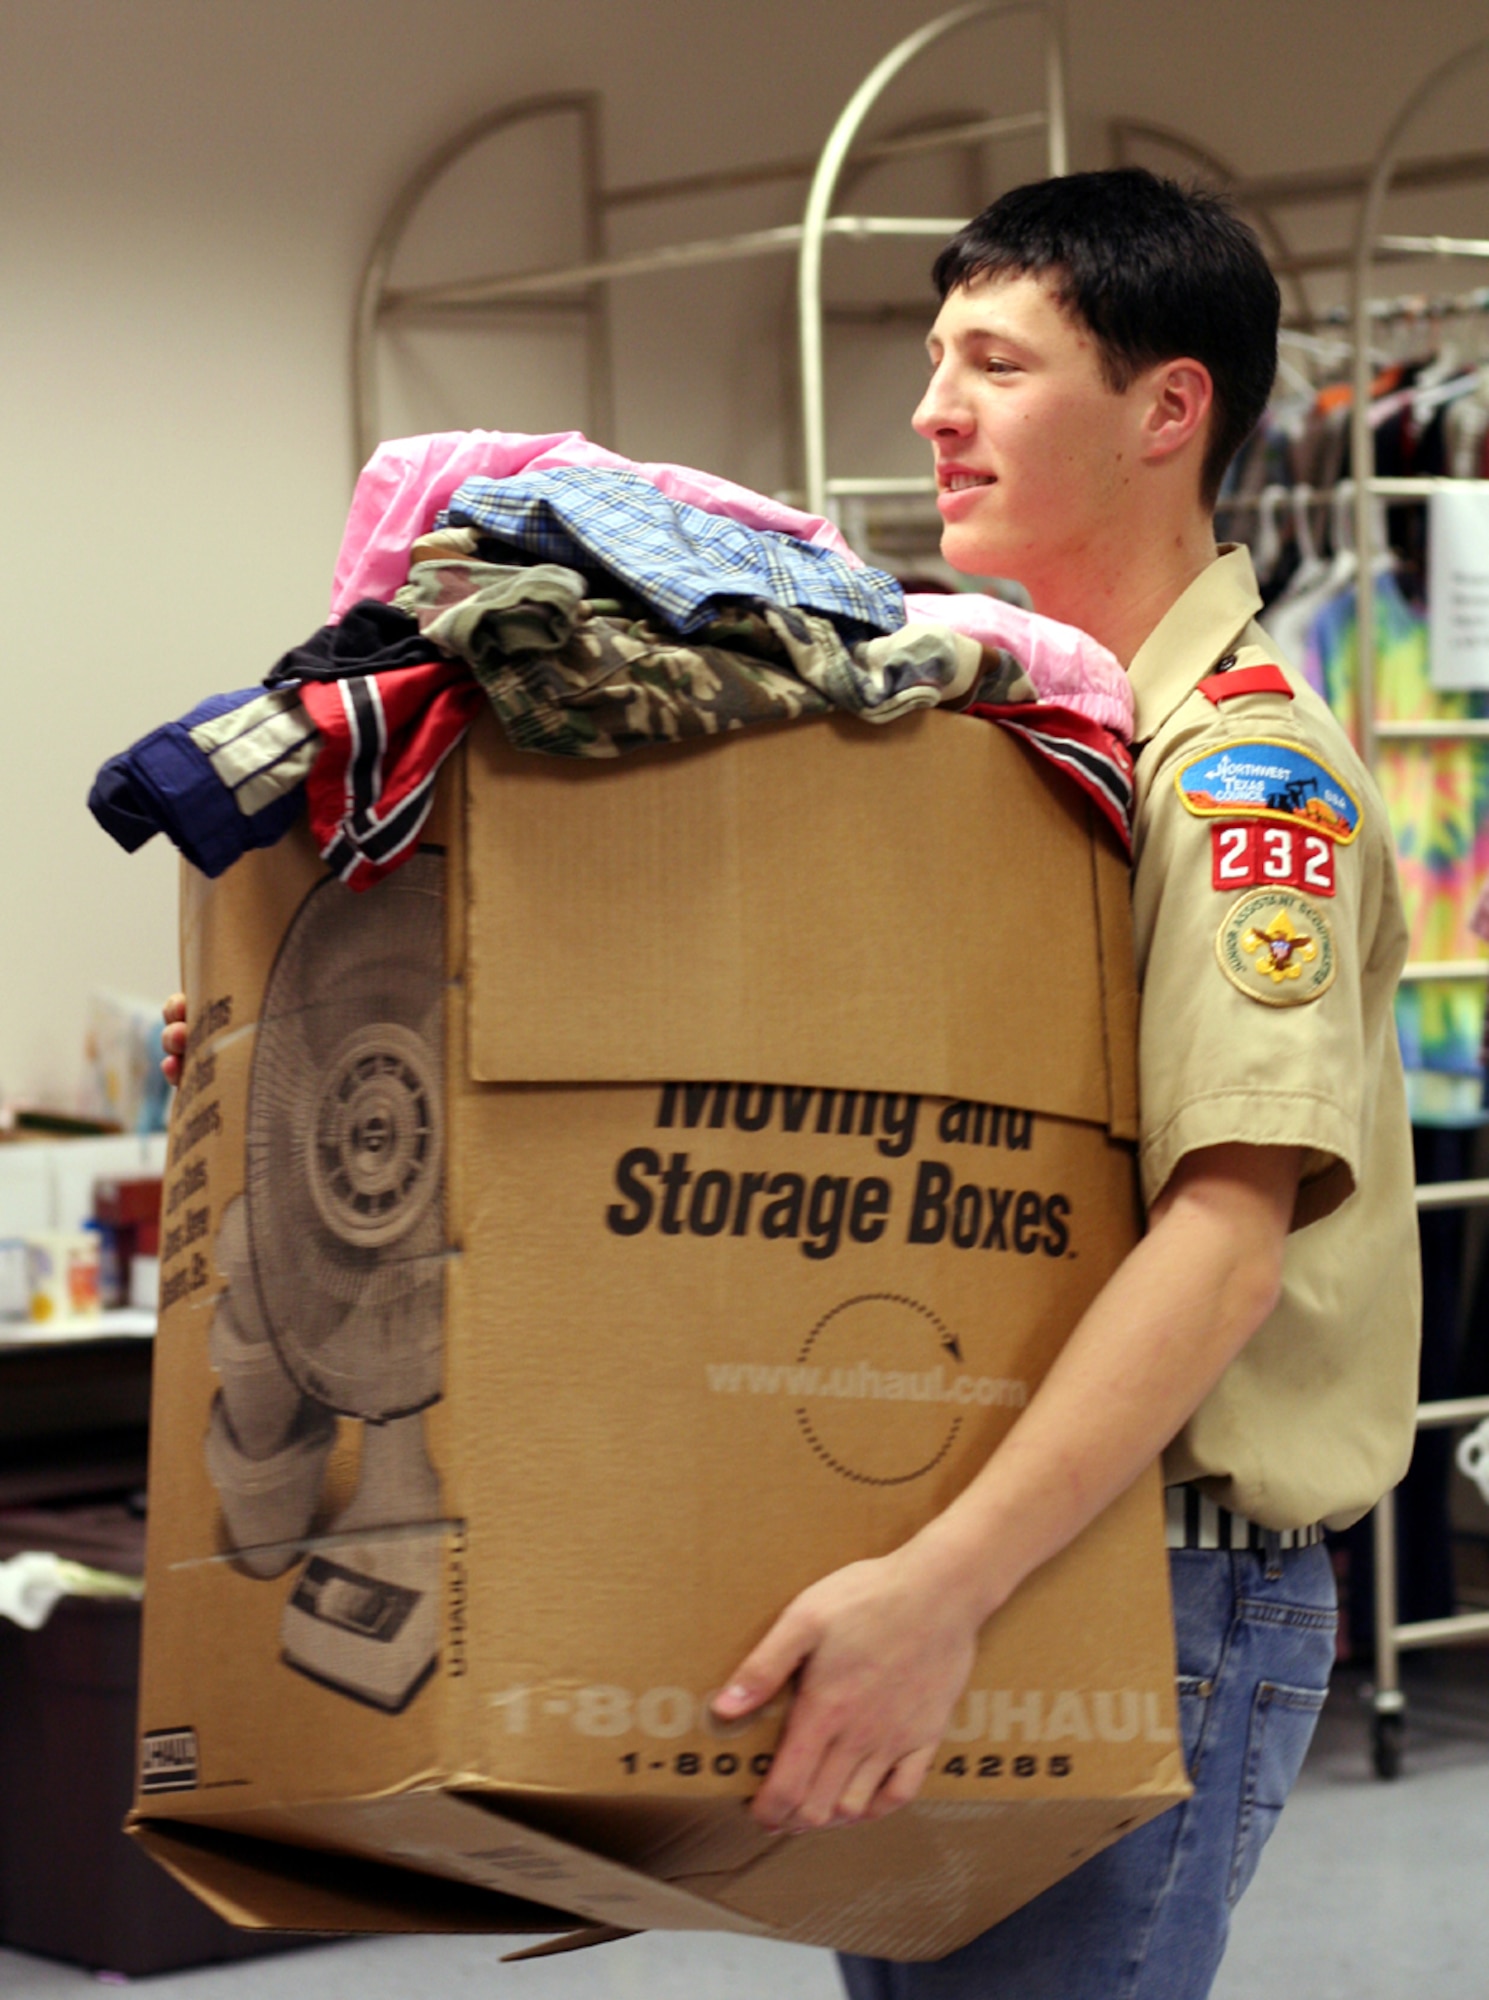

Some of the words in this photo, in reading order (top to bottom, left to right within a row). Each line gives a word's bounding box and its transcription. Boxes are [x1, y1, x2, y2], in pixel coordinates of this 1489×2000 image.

[1205, 755, 1292, 781] NORTHWEST
[1222, 776, 1266, 792] TEXAS
[1214, 789, 1267, 802] COUNCIL
[1219, 827, 1332, 888] 232
[605, 1146, 892, 1260] Storage
[704, 1360, 1028, 1407] www.uhaul.com
